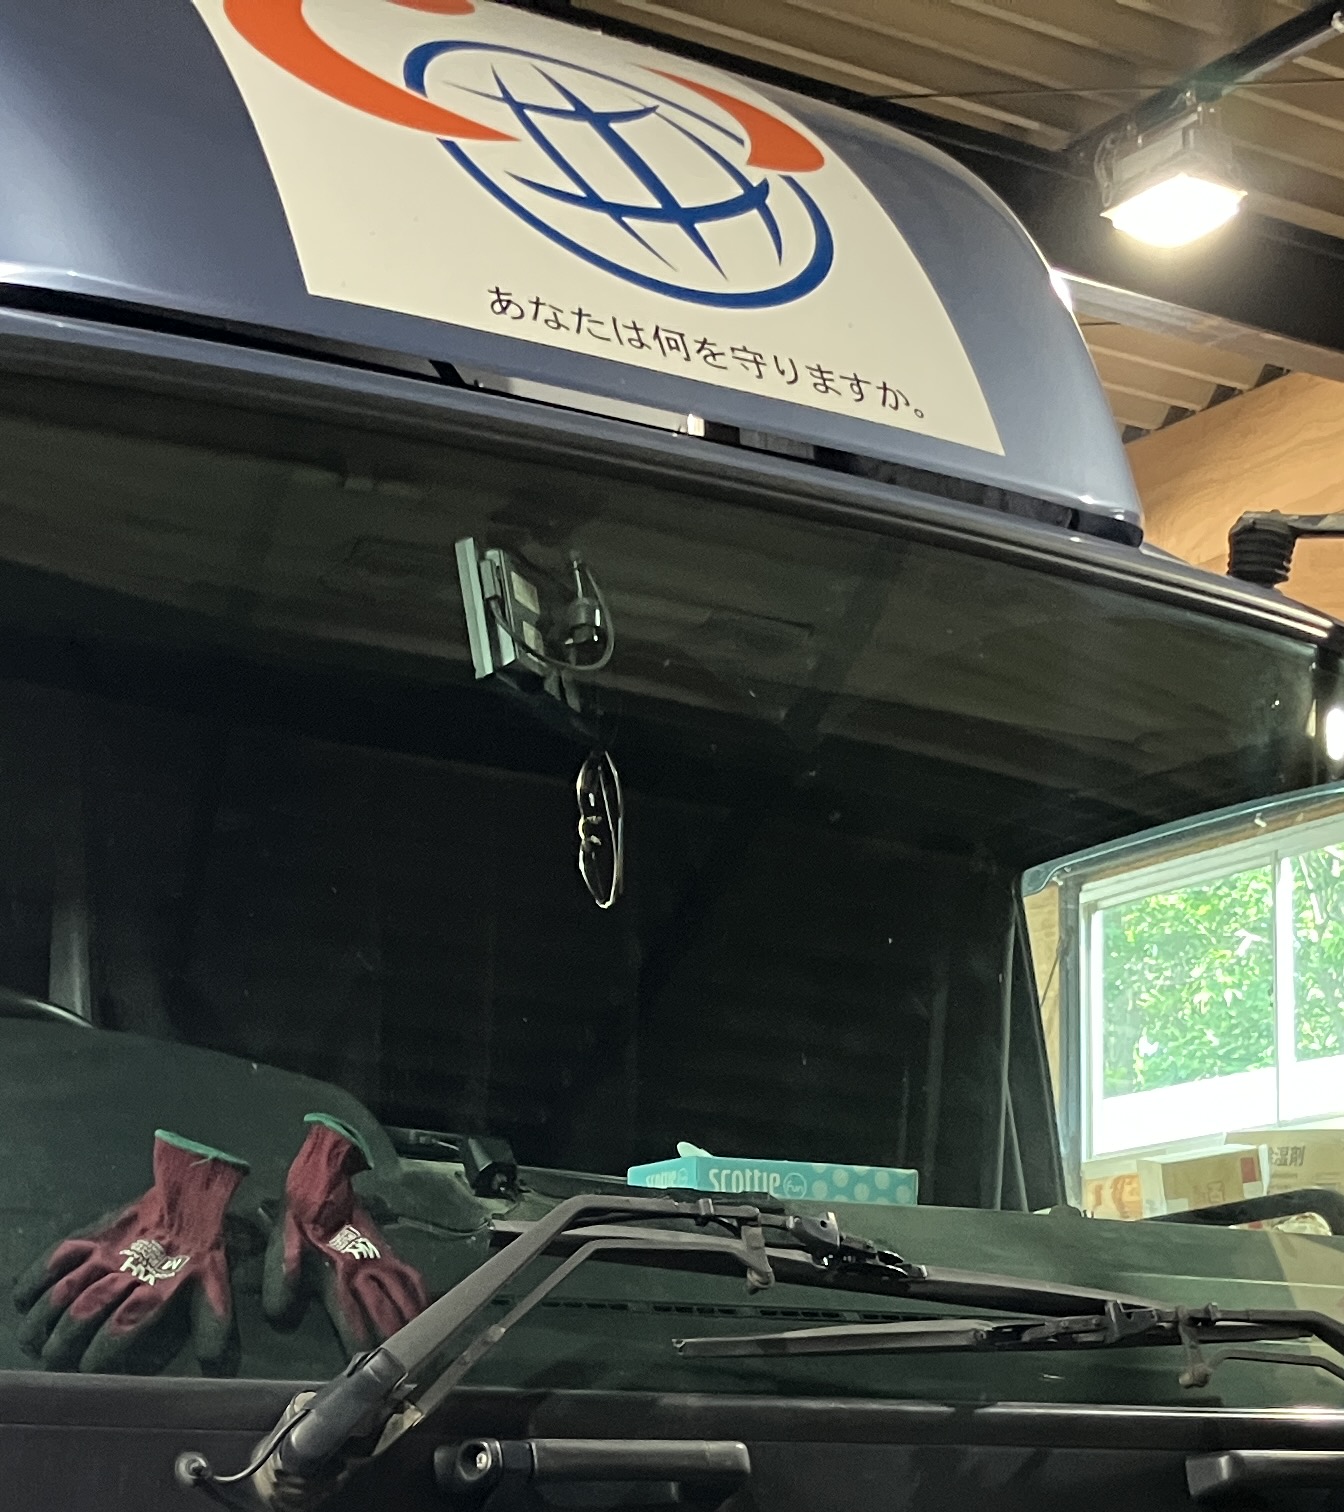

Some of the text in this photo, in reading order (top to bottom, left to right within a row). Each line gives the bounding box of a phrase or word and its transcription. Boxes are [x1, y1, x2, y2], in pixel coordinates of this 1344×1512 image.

[487, 285, 927, 421] あなたは何を守りますか。
[709, 1168, 782, 1198] scottie
